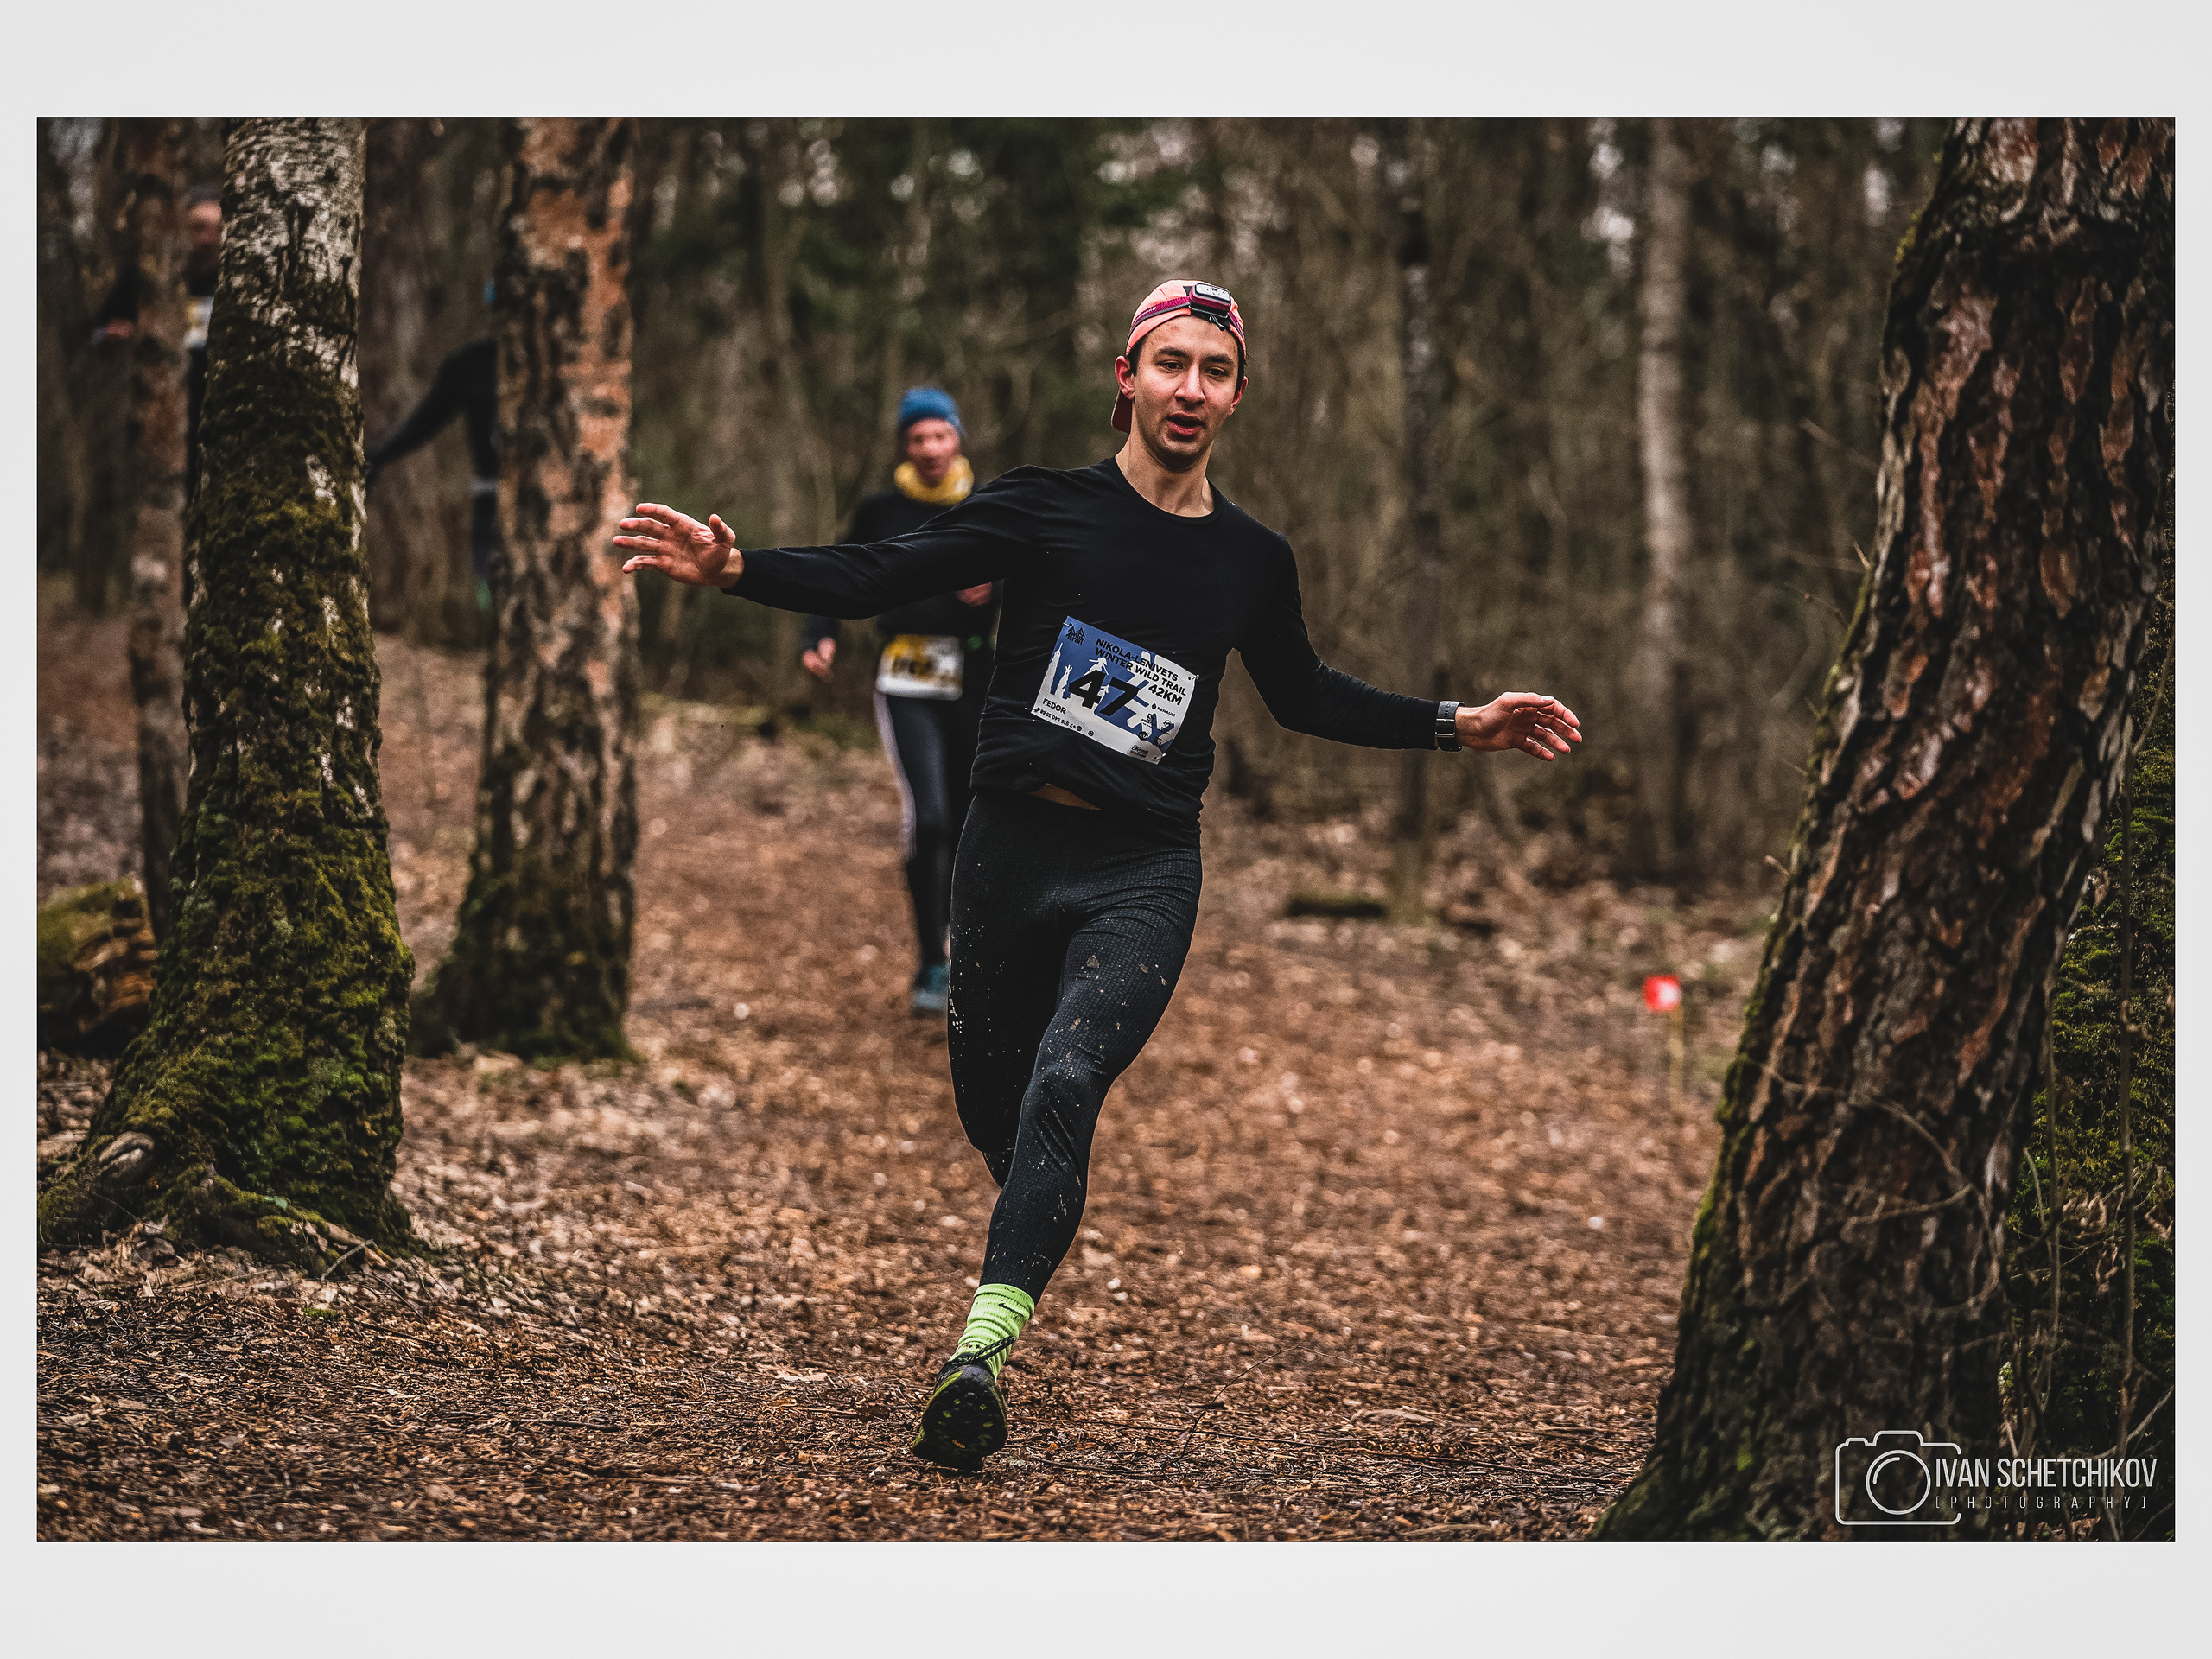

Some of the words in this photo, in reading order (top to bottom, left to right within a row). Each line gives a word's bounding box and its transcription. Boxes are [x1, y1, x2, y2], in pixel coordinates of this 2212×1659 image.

[1096, 638, 1179, 681] NIKOLA-LENIVETS
[1096, 647, 1134, 671] WINTER
[1135, 667, 1160, 682] WILD
[1161, 679, 1186, 696] TRAIL
[1042, 698, 1067, 714] FEDOR
[1068, 670, 1140, 717] 47
[1148, 684, 1183, 706] 42KM
